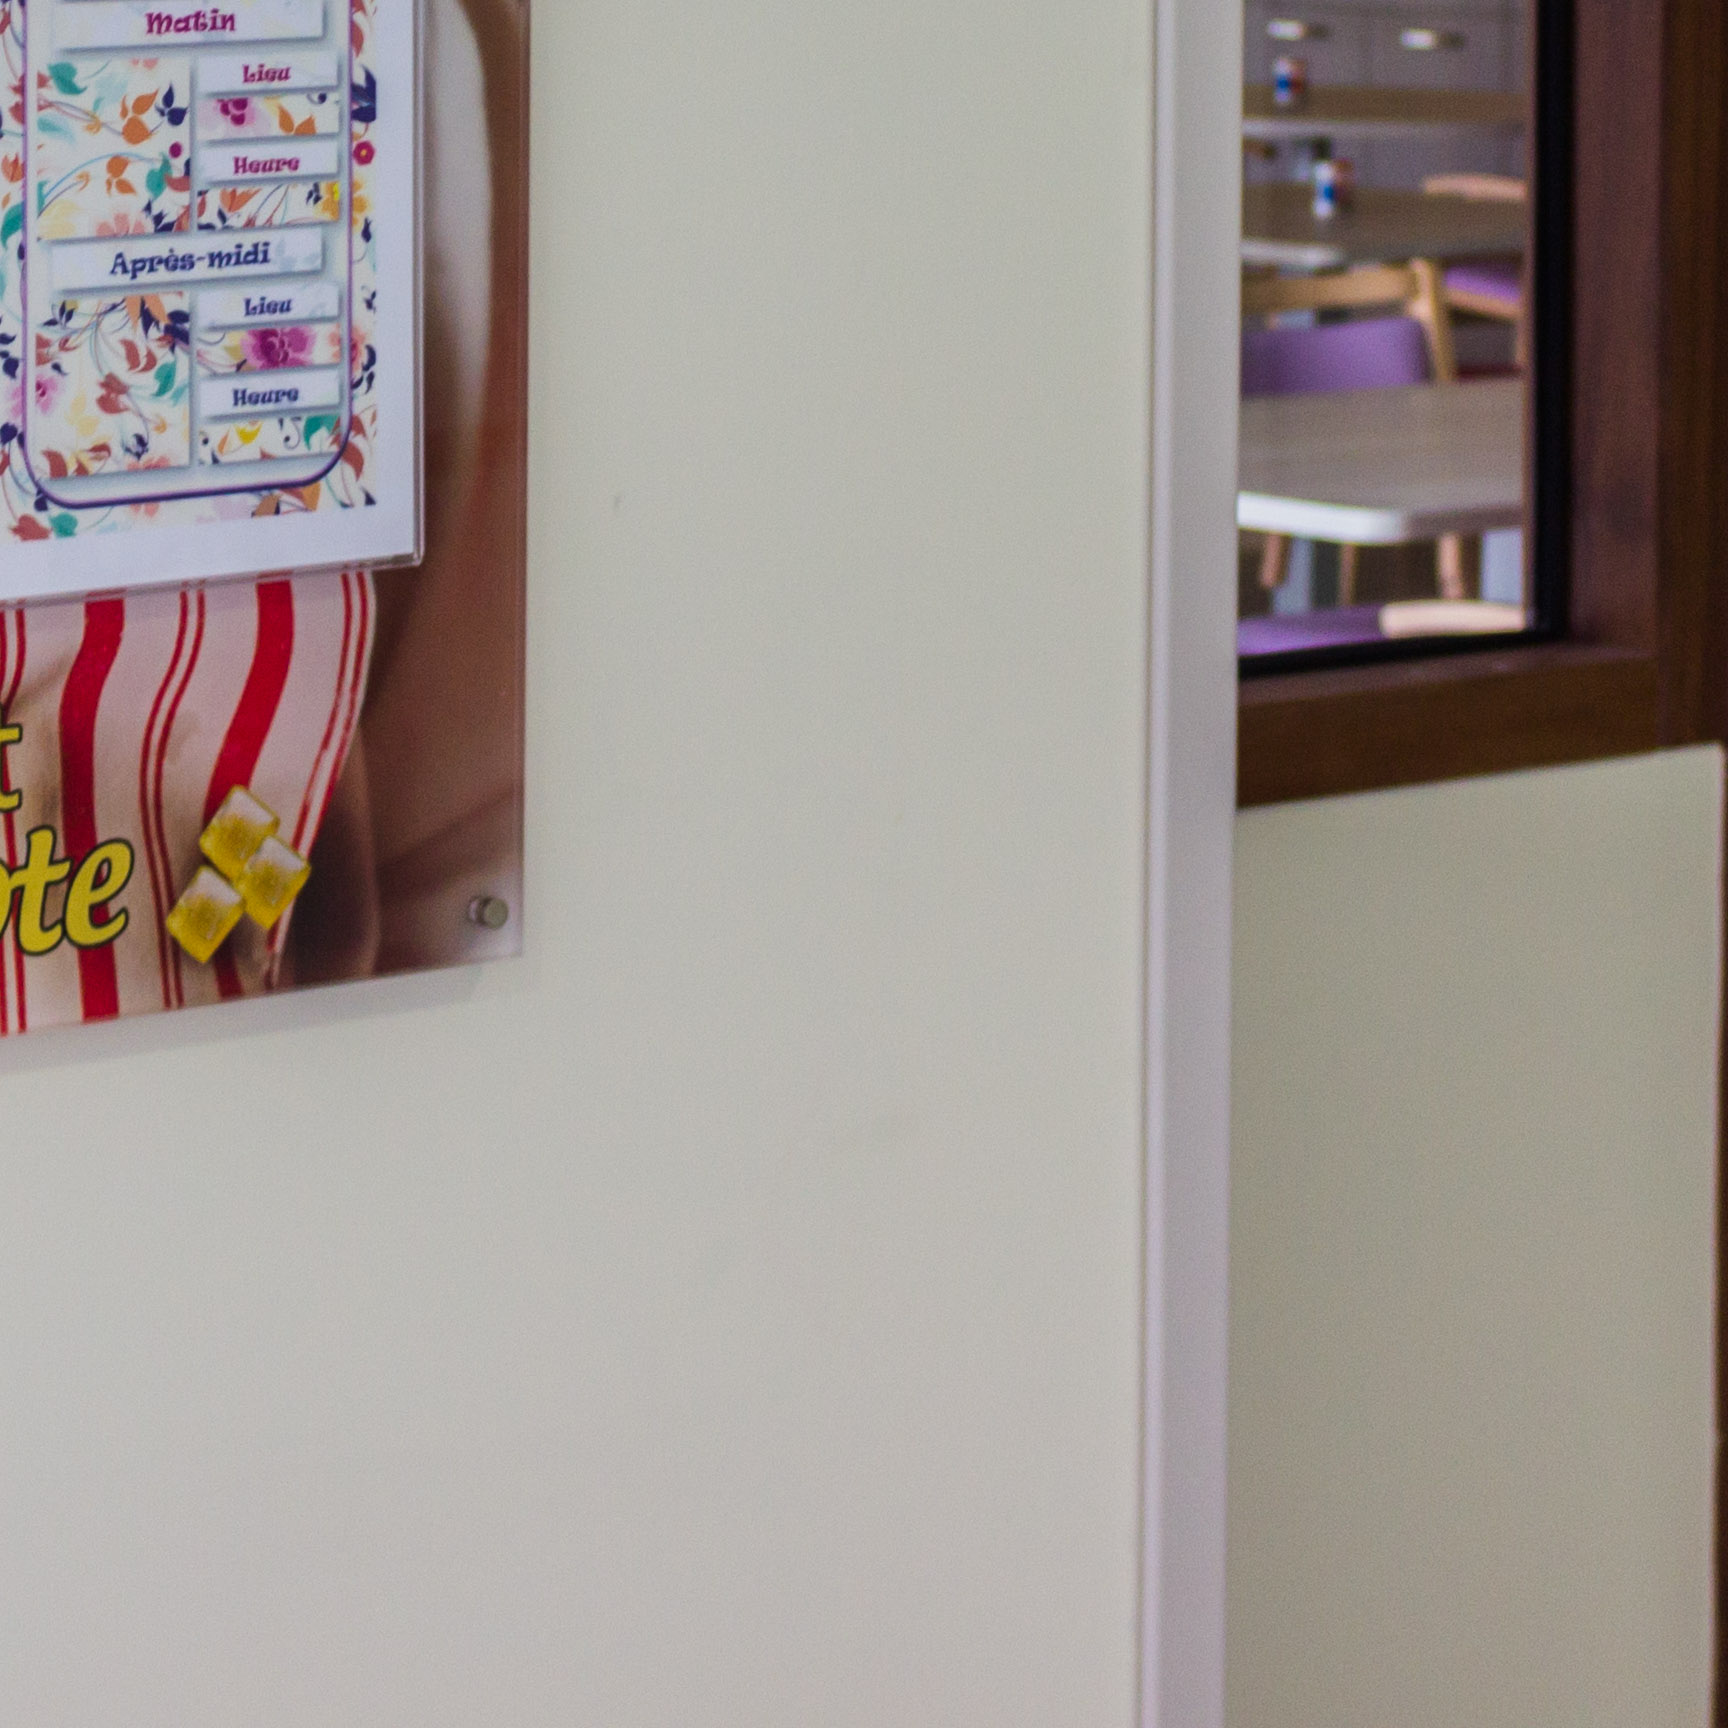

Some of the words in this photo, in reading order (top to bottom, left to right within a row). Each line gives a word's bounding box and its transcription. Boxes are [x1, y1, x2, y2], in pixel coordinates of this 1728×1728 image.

[144, 8, 237, 38] Matin
[241, 61, 292, 85] Lieu
[232, 151, 301, 177] Heure
[109, 241, 272, 279] Après-midi
[243, 293, 293, 318] Lieu
[231, 382, 300, 409] Heure
